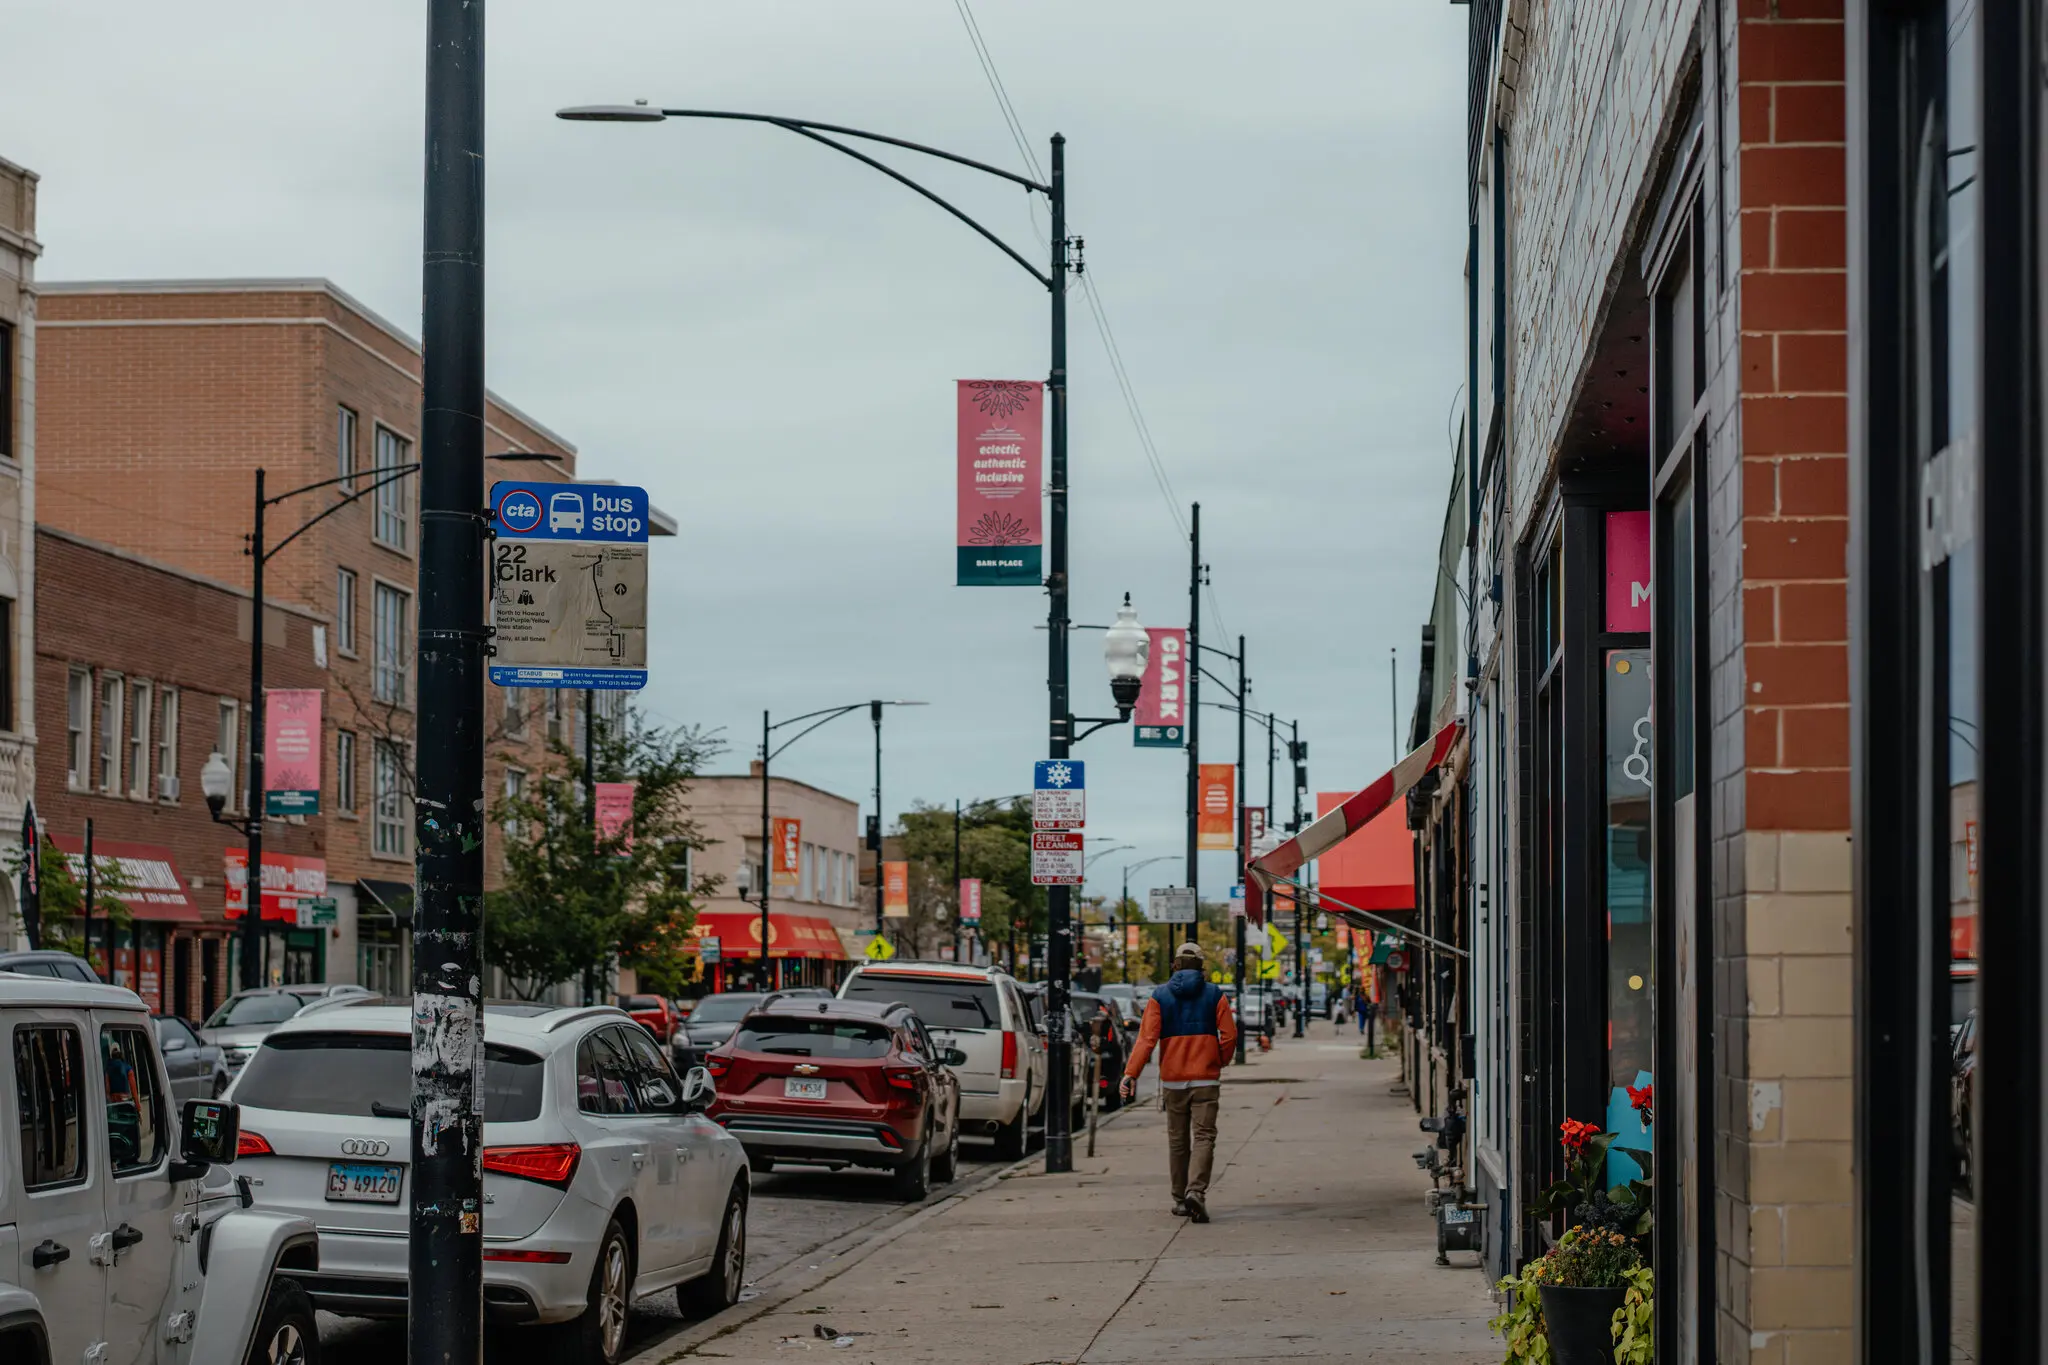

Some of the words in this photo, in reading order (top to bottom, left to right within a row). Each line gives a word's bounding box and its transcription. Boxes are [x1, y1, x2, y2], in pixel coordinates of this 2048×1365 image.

[979, 443, 1021, 455] eclectic
[973, 457, 1027, 469] authentic
[975, 471, 1024, 483] inclusive
[506, 503, 535, 518] cta
[592, 492, 633, 513] bus
[592, 514, 641, 537] stop
[498, 545, 527, 564] 22
[498, 564, 557, 583] Clark
[1160, 636, 1180, 718] CLARK
[330, 1174, 347, 1191] CS
[354, 1175, 397, 1193] 49120
